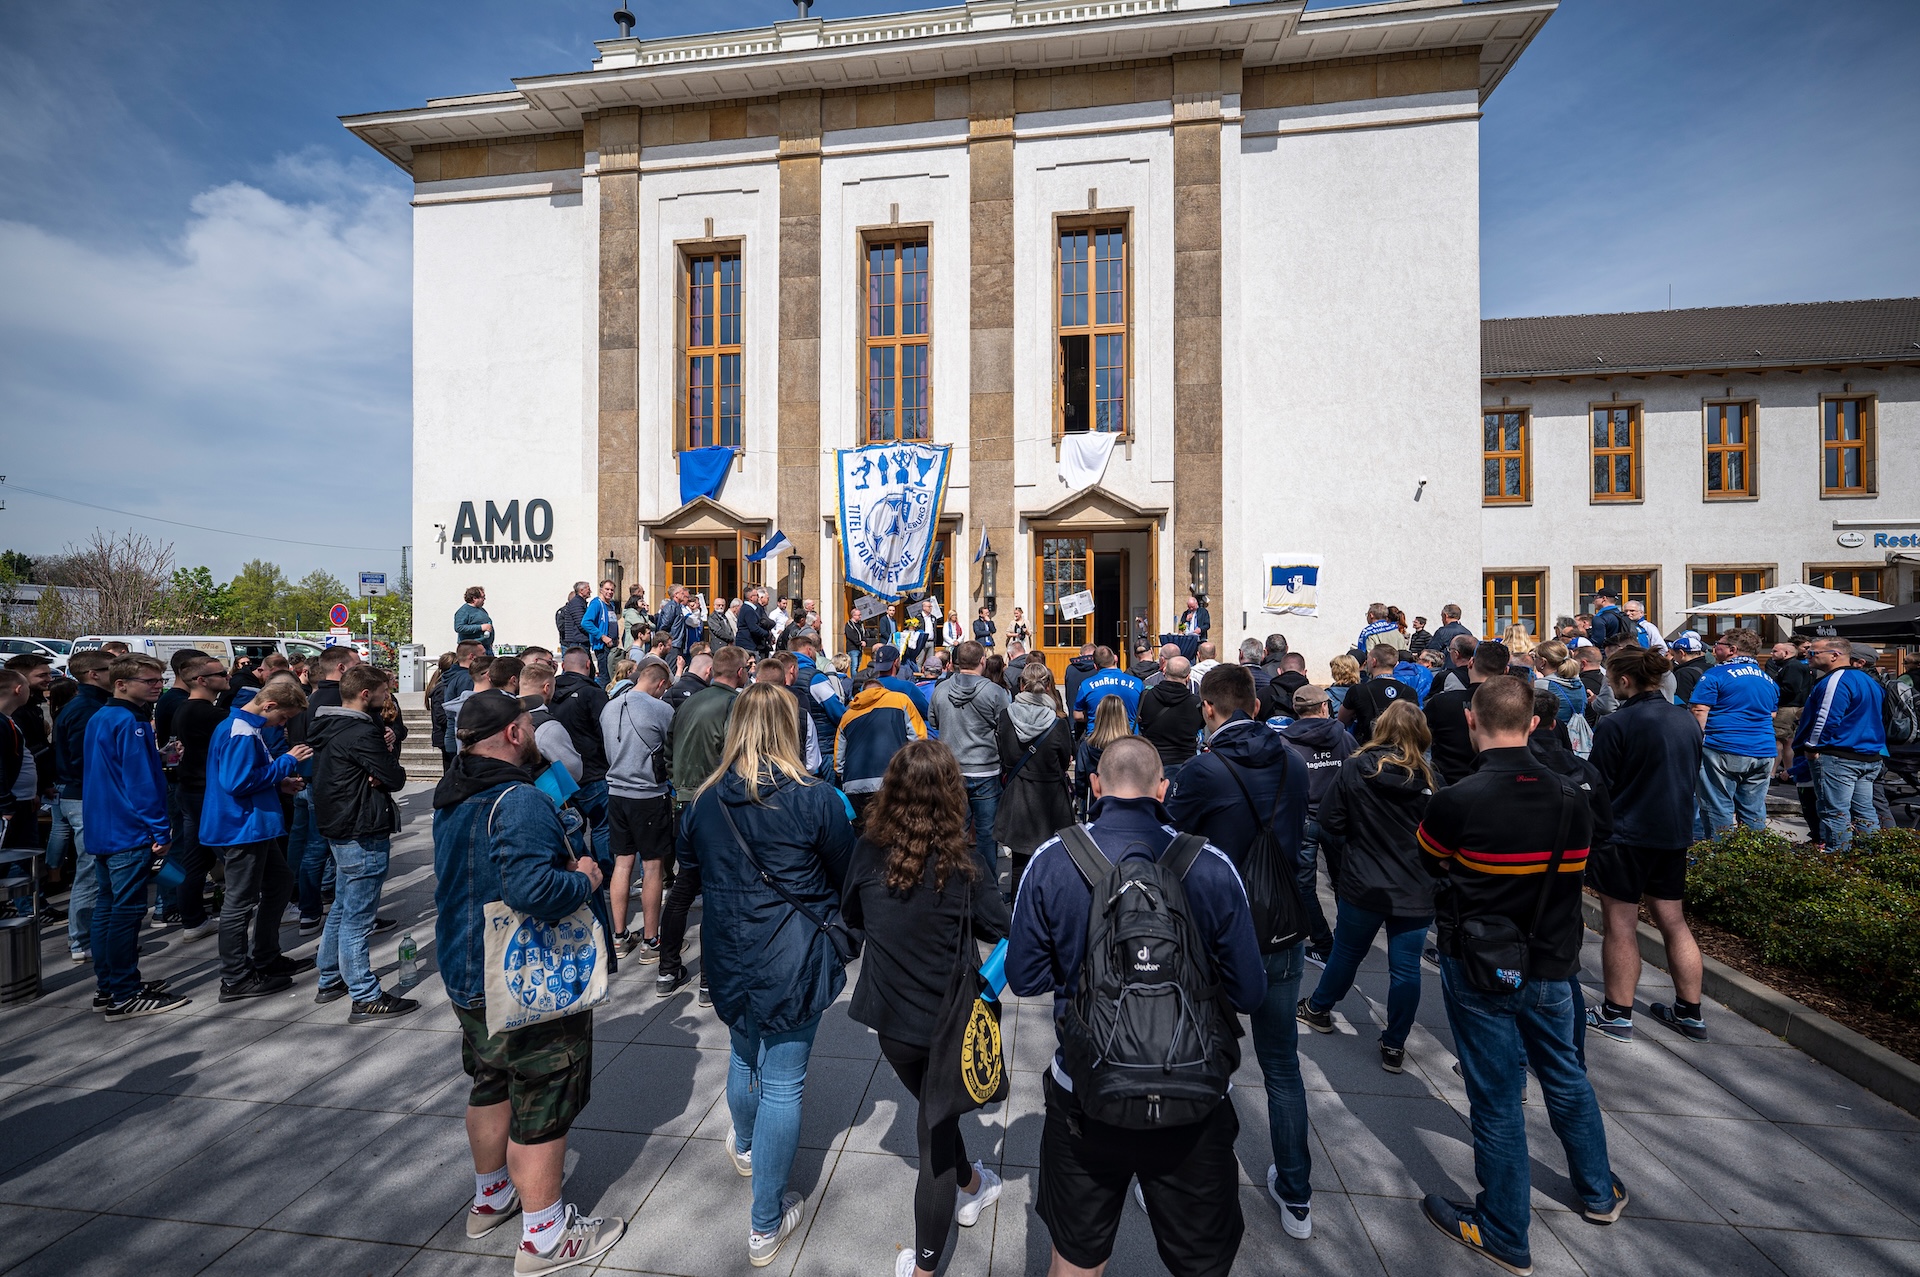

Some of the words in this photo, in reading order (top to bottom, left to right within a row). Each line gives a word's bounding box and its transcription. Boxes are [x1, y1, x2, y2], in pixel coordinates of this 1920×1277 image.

[452, 498, 554, 544] AMO
[849, 504, 861, 533] TITEL
[1874, 532, 1920, 548] Rest
[452, 544, 554, 564] KULTURHAUS
[1727, 666, 1763, 678] FanRat
[1089, 676, 1118, 689] FanRat
[1121, 679, 1134, 689] e.V.
[1321, 751, 1331, 759] FC
[1134, 962, 1160, 971] deuter
[559, 1237, 584, 1258] N
